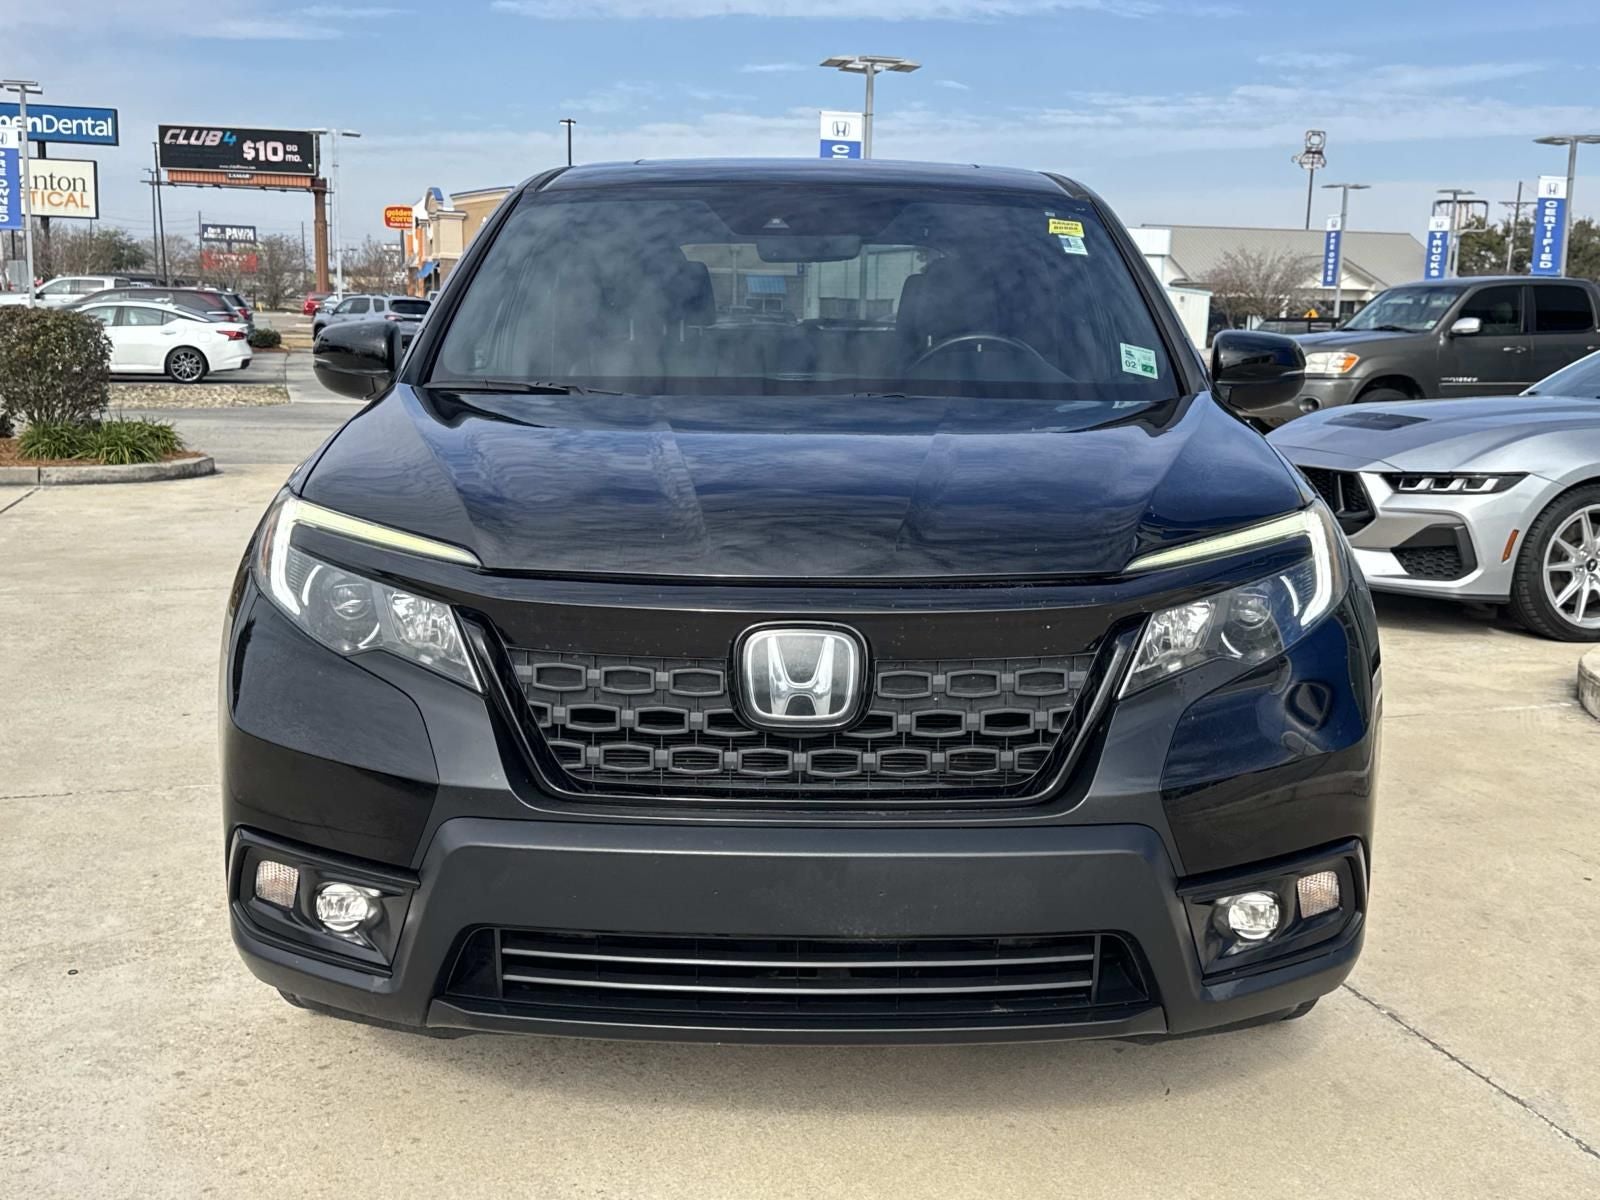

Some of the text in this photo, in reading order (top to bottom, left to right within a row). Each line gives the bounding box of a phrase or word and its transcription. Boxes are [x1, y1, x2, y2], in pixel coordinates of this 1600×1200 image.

[242, 140, 284, 162] $10
[29, 172, 88, 193] nton
[28, 190, 90, 209] TICAL
[1539, 200, 1558, 269] CERTIFIED
[1429, 232, 1443, 277] TRUCKS
[1125, 360, 1137, 369] 02
